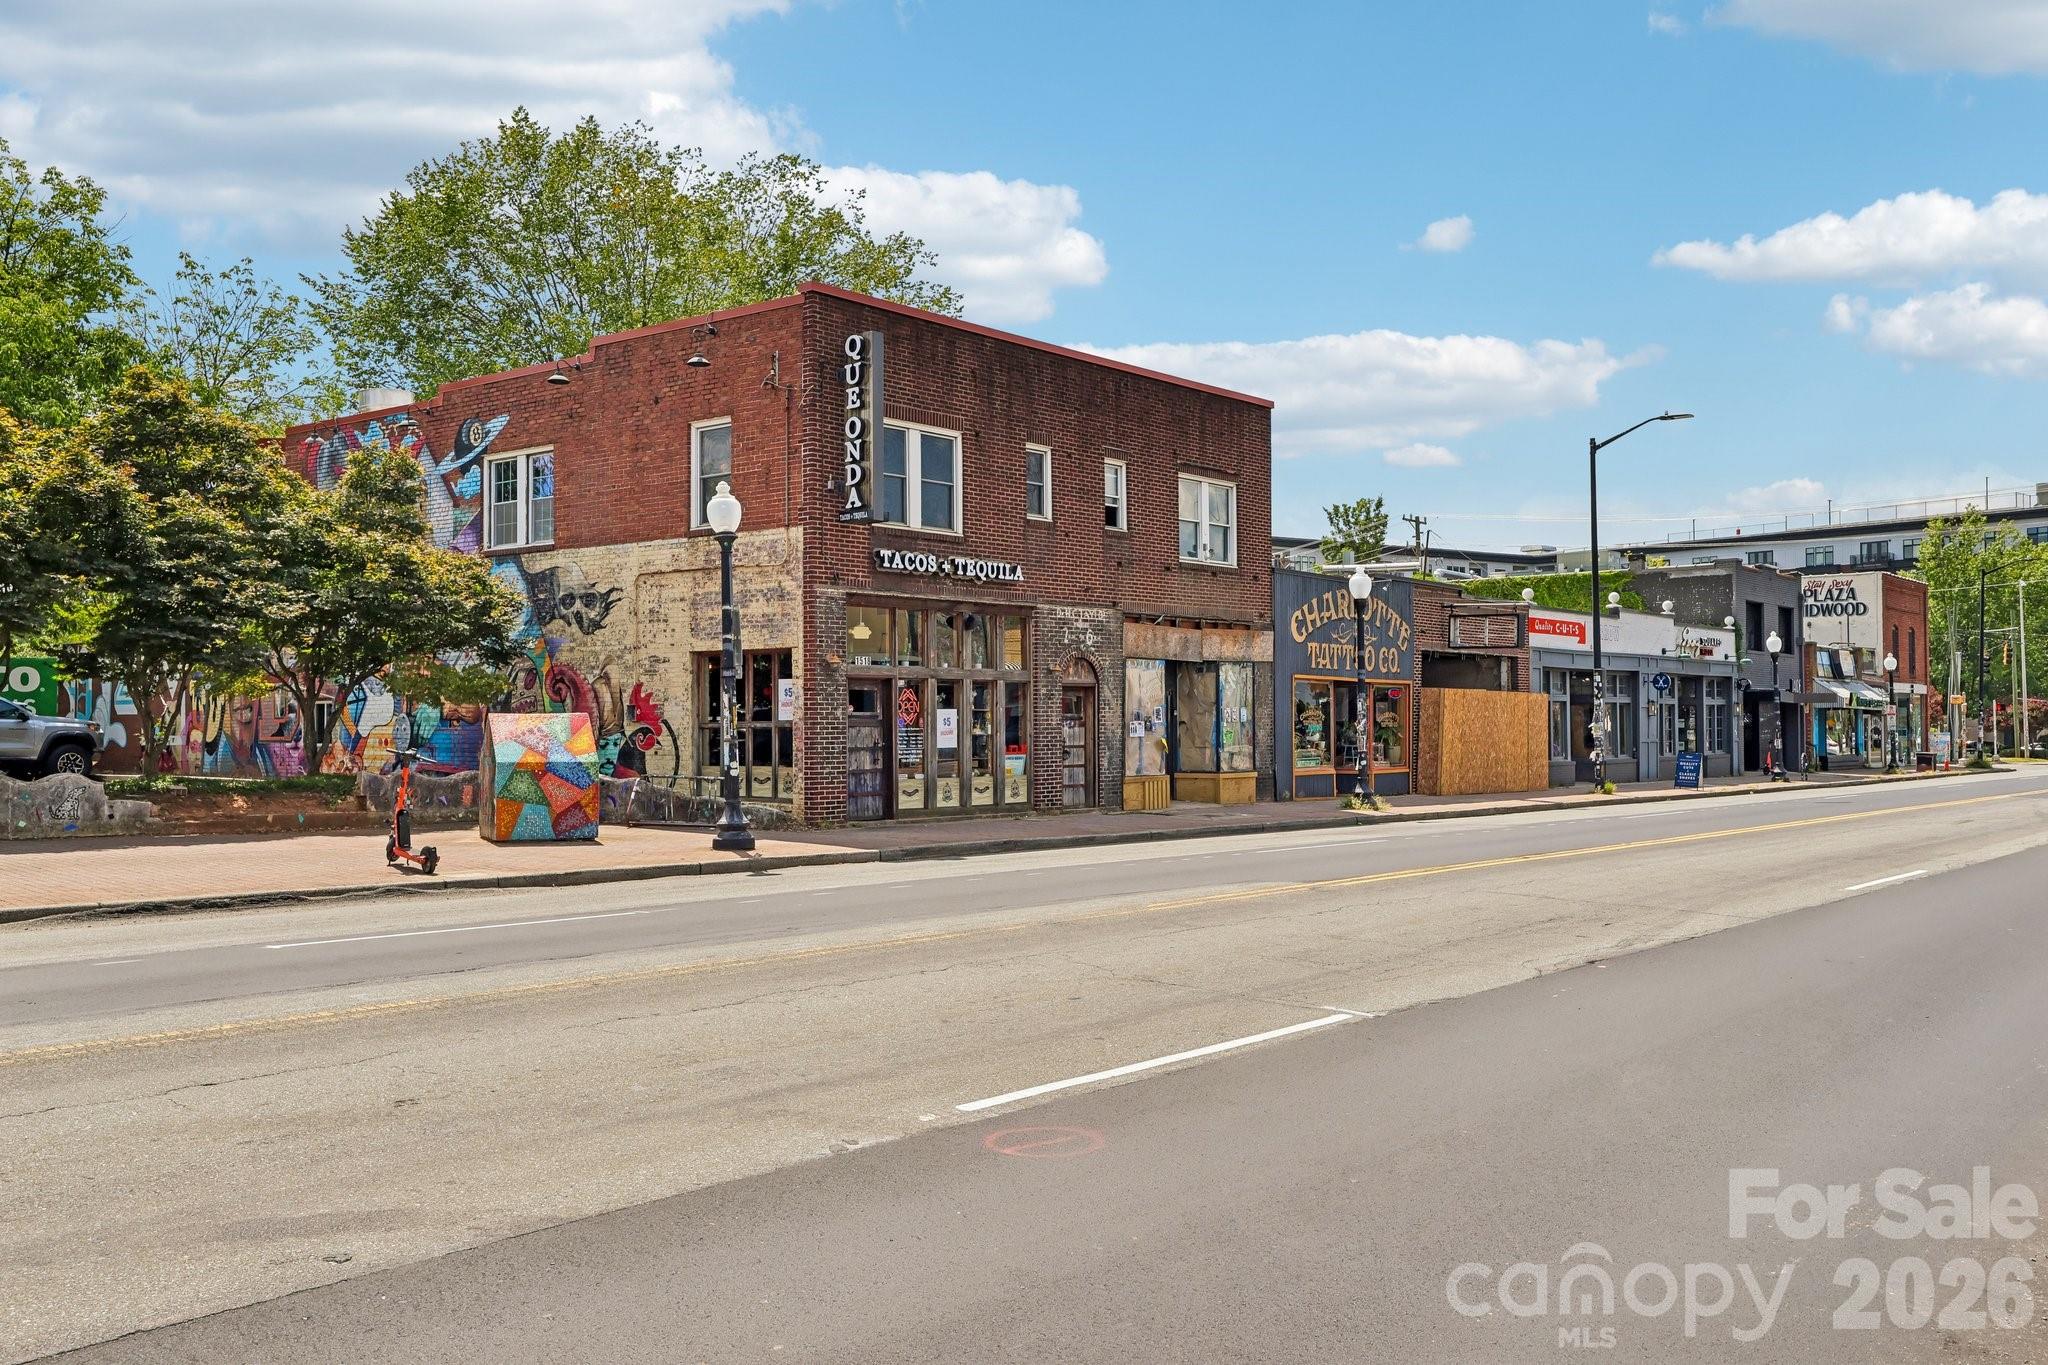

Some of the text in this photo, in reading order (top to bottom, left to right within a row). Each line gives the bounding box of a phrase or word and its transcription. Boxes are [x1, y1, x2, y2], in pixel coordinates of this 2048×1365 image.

[844, 334, 863, 509] QUE ONDA
[880, 549, 937, 573] TACOS
[954, 558, 1024, 581] TEQUILA
[1803, 587, 1857, 602] PLAZA
[1804, 579, 1854, 596] Stay Sexy
[1803, 602, 1869, 618] IDWOOD
[1534, 619, 1553, 633] Quality
[1379, 646, 1400, 673] CO.
[898, 701, 920, 713] OPEN
[943, 717, 952, 727] $5
